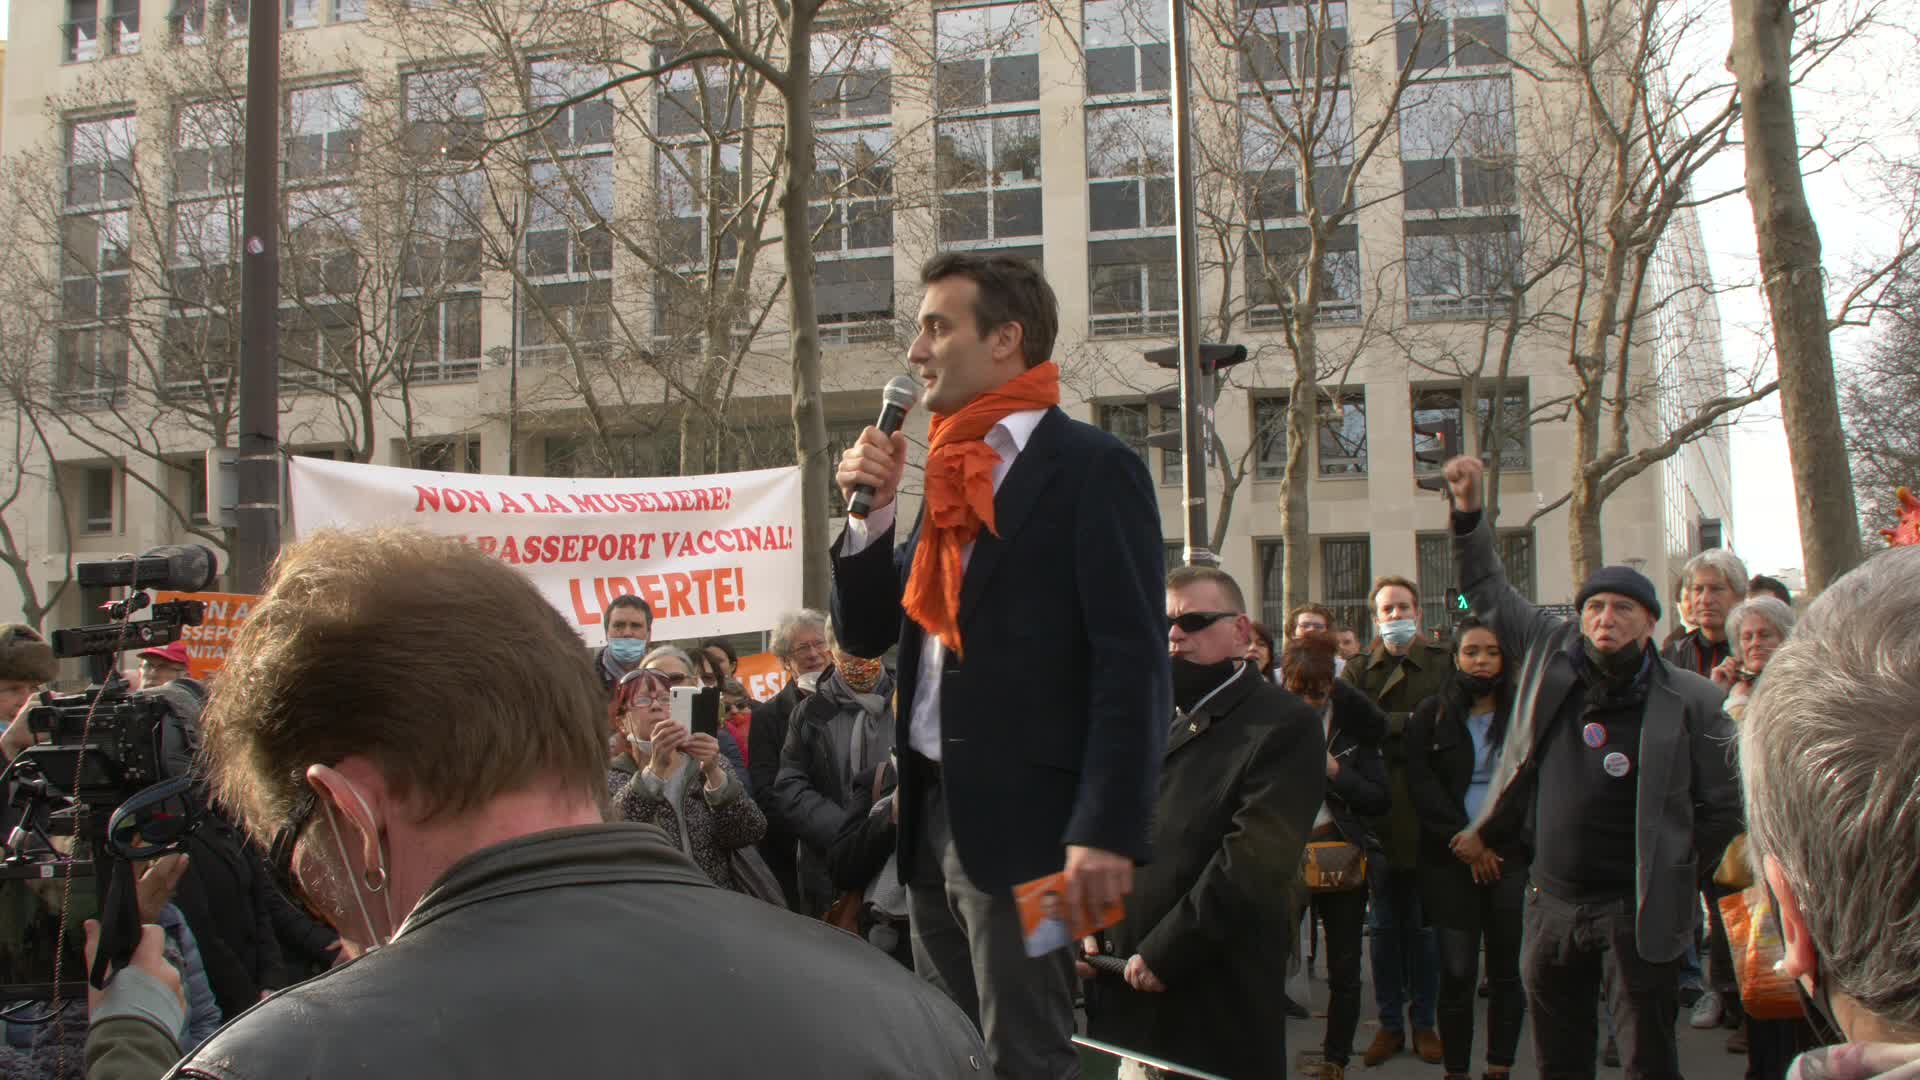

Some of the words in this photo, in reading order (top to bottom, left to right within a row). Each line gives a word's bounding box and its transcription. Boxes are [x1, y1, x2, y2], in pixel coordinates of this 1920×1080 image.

[414, 485, 491, 513] NON
[499, 491, 526, 513] A
[522, 492, 573, 513] LA
[568, 487, 732, 513] MUSELIERE!
[661, 525, 793, 560] VACCINAL!
